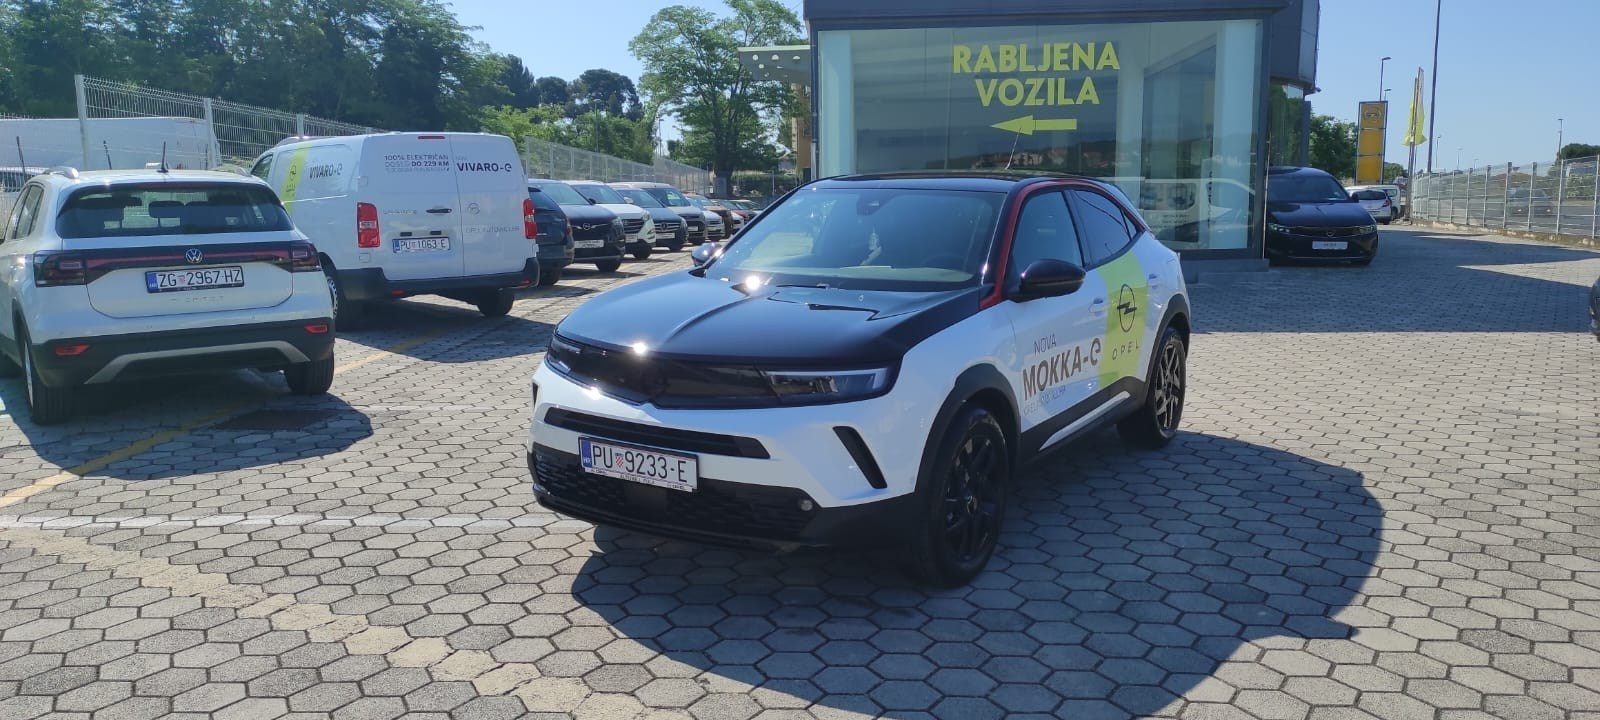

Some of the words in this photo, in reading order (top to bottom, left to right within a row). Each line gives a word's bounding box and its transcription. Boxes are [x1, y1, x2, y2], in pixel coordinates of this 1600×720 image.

[953, 41, 1120, 73] RABLJENA
[975, 76, 1100, 107] VOZILA
[1033, 333, 1057, 355] NOVA
[1111, 338, 1139, 361] OPEL
